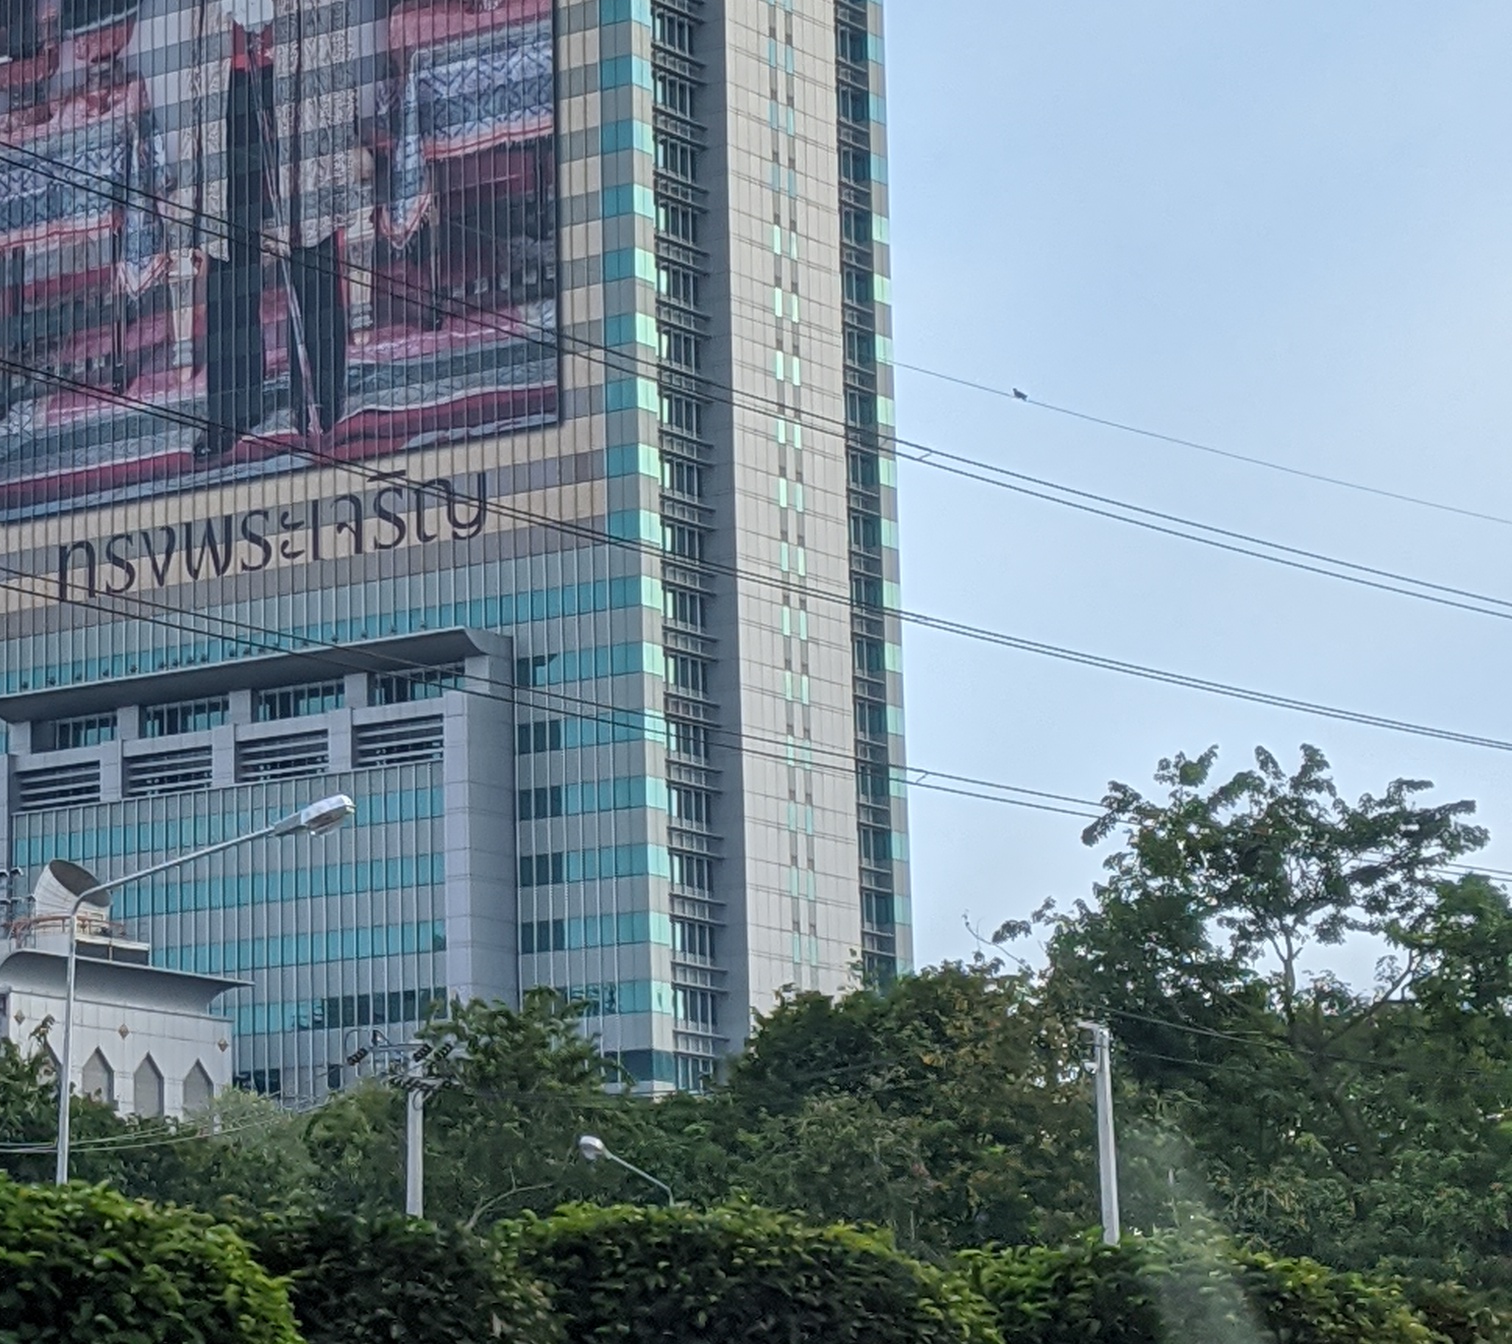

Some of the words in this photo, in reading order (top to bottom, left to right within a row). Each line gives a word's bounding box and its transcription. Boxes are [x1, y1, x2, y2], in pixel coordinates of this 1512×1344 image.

[58, 469, 488, 601] ทรงพระเจริญ
